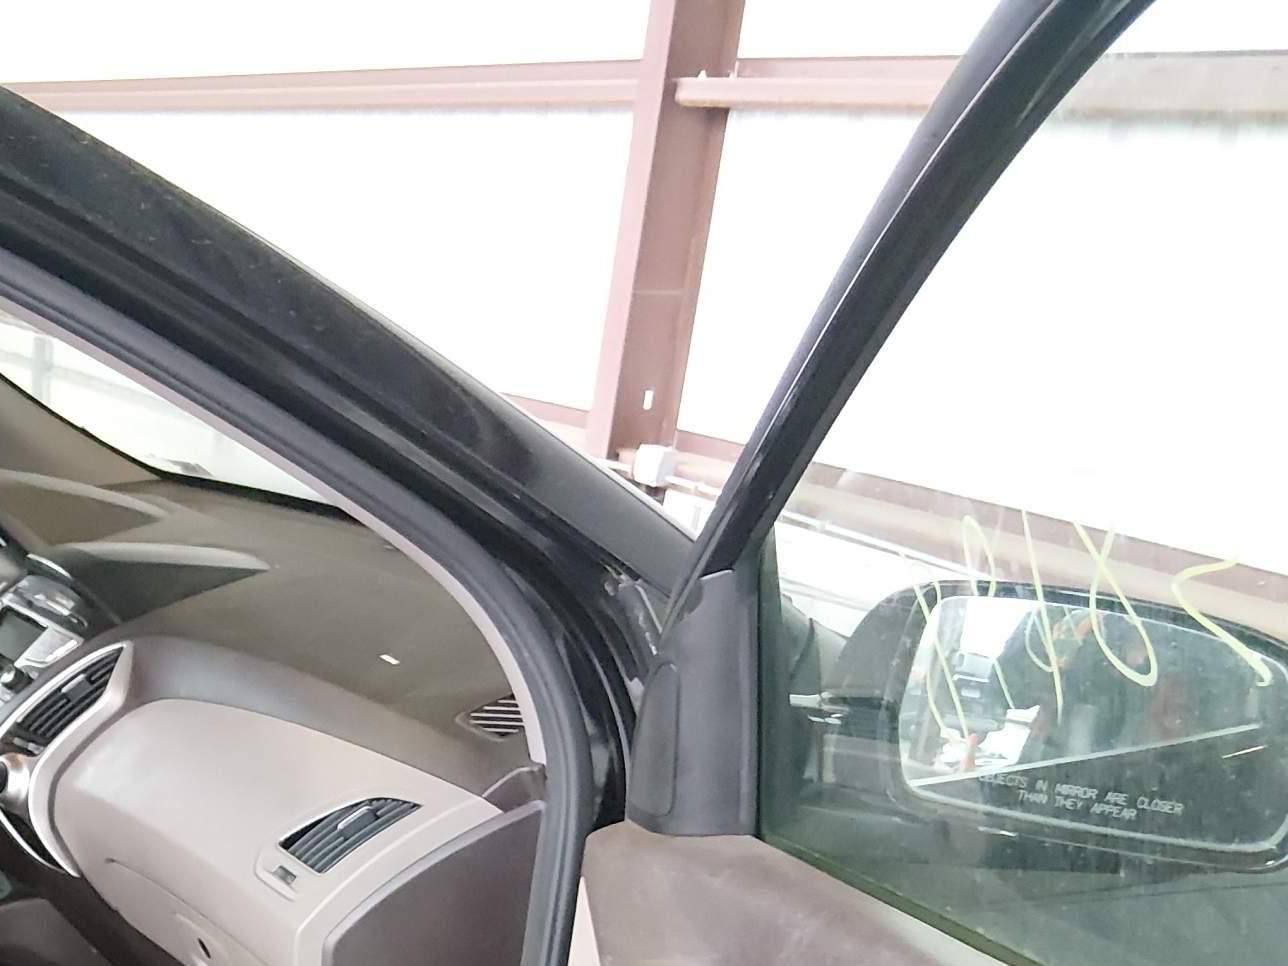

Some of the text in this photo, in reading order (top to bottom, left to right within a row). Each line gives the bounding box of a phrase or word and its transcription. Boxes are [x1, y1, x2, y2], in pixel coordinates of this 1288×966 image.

[1019, 789, 1138, 820] THAN THEY APPEAR
[1036, 779, 1048, 793] IN
[1055, 783, 1098, 801] MIRROR
[1105, 791, 1129, 806] ARE
[1137, 797, 1185, 816] CLOSER
